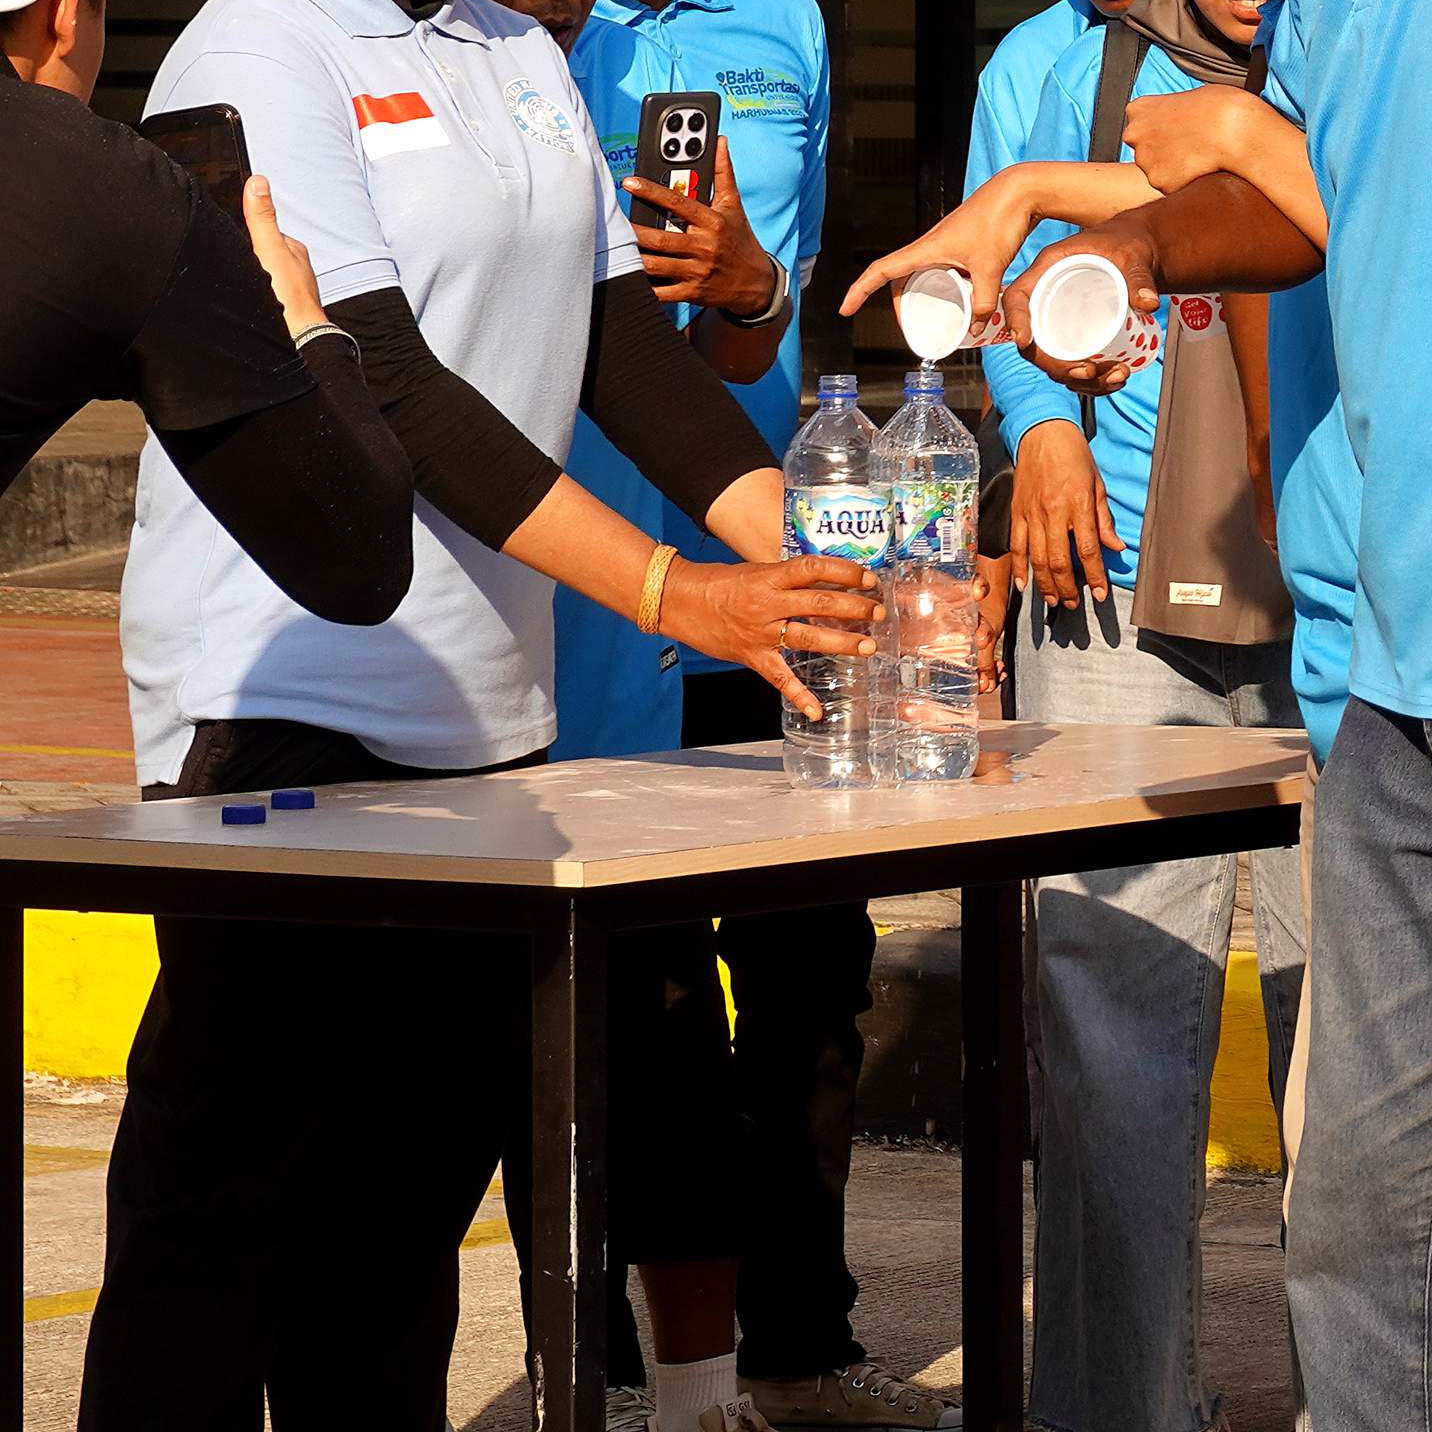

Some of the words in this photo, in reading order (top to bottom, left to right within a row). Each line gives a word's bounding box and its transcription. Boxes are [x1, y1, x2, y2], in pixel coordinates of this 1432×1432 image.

[726, 67, 764, 85] Bakti
[718, 79, 800, 96] Transportasi
[816, 510, 886, 540] AQUA
